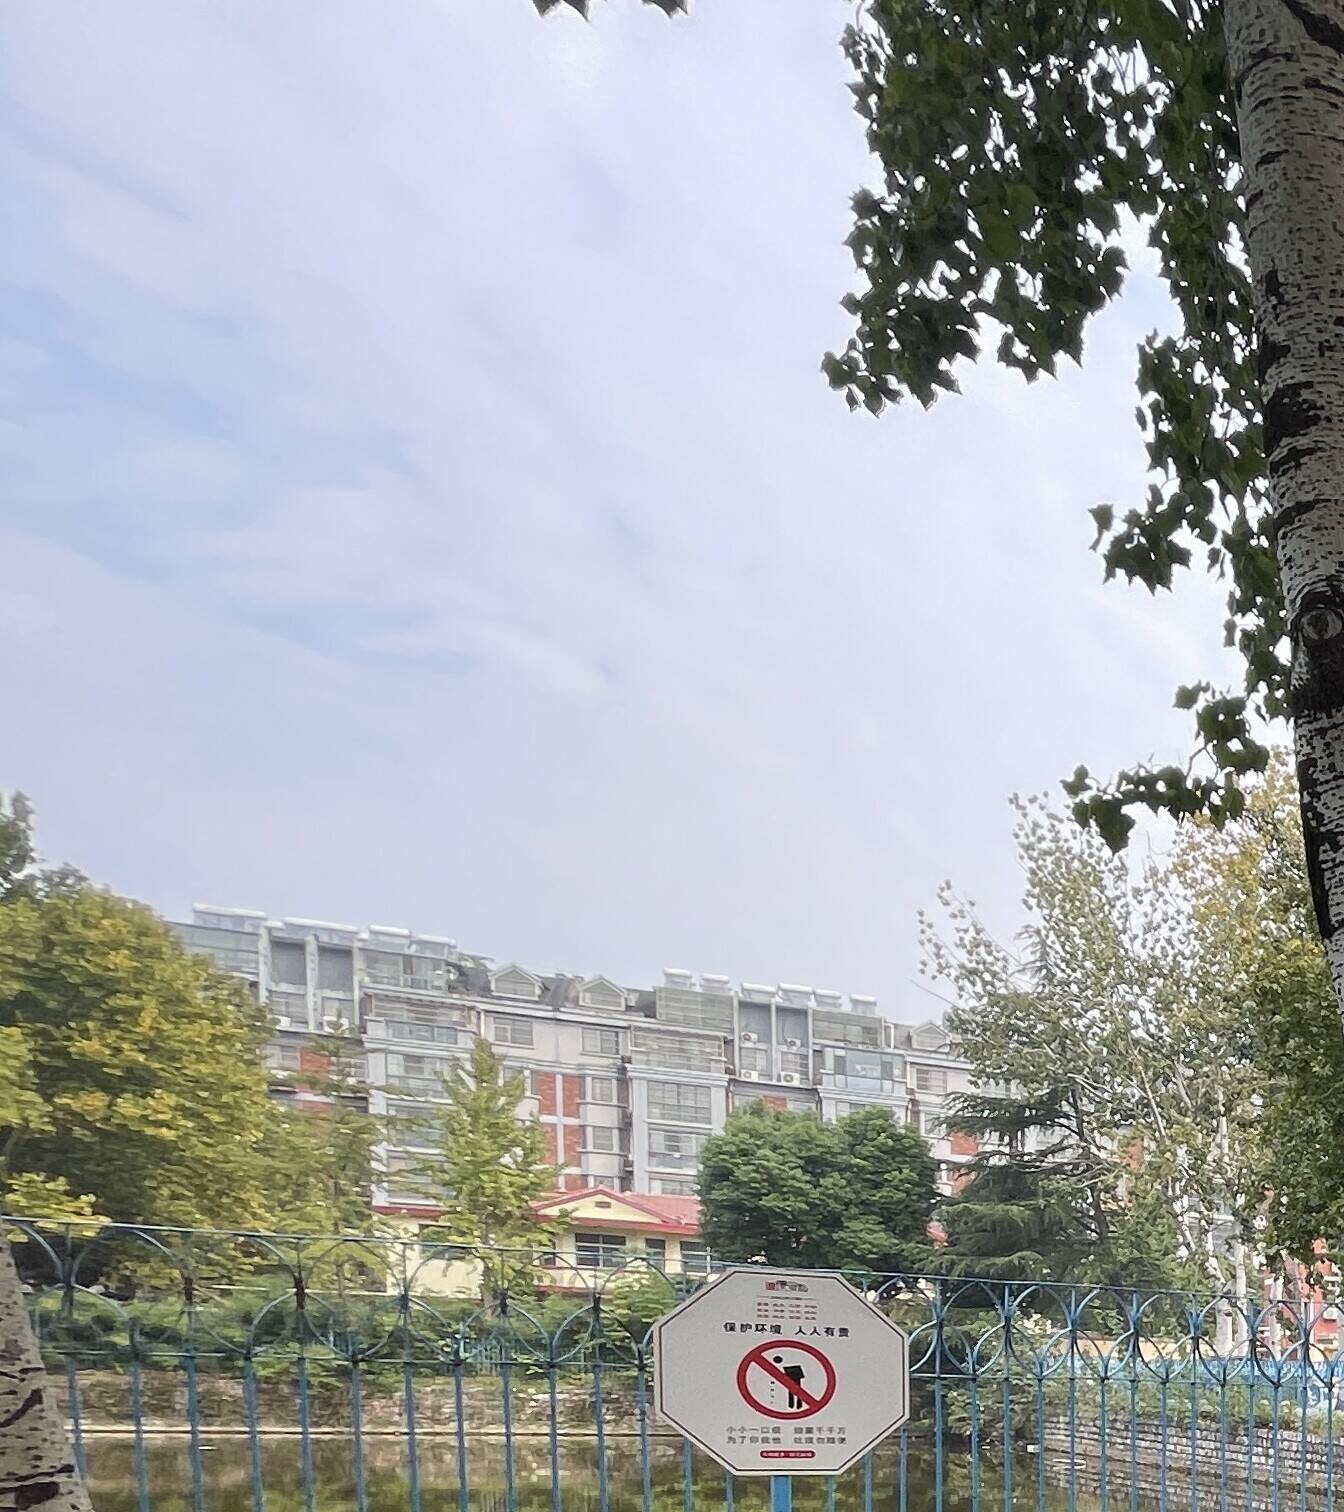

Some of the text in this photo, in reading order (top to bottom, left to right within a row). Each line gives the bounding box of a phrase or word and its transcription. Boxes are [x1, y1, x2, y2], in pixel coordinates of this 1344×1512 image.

[723, 1322, 849, 1338] 保护环境 人人有责
